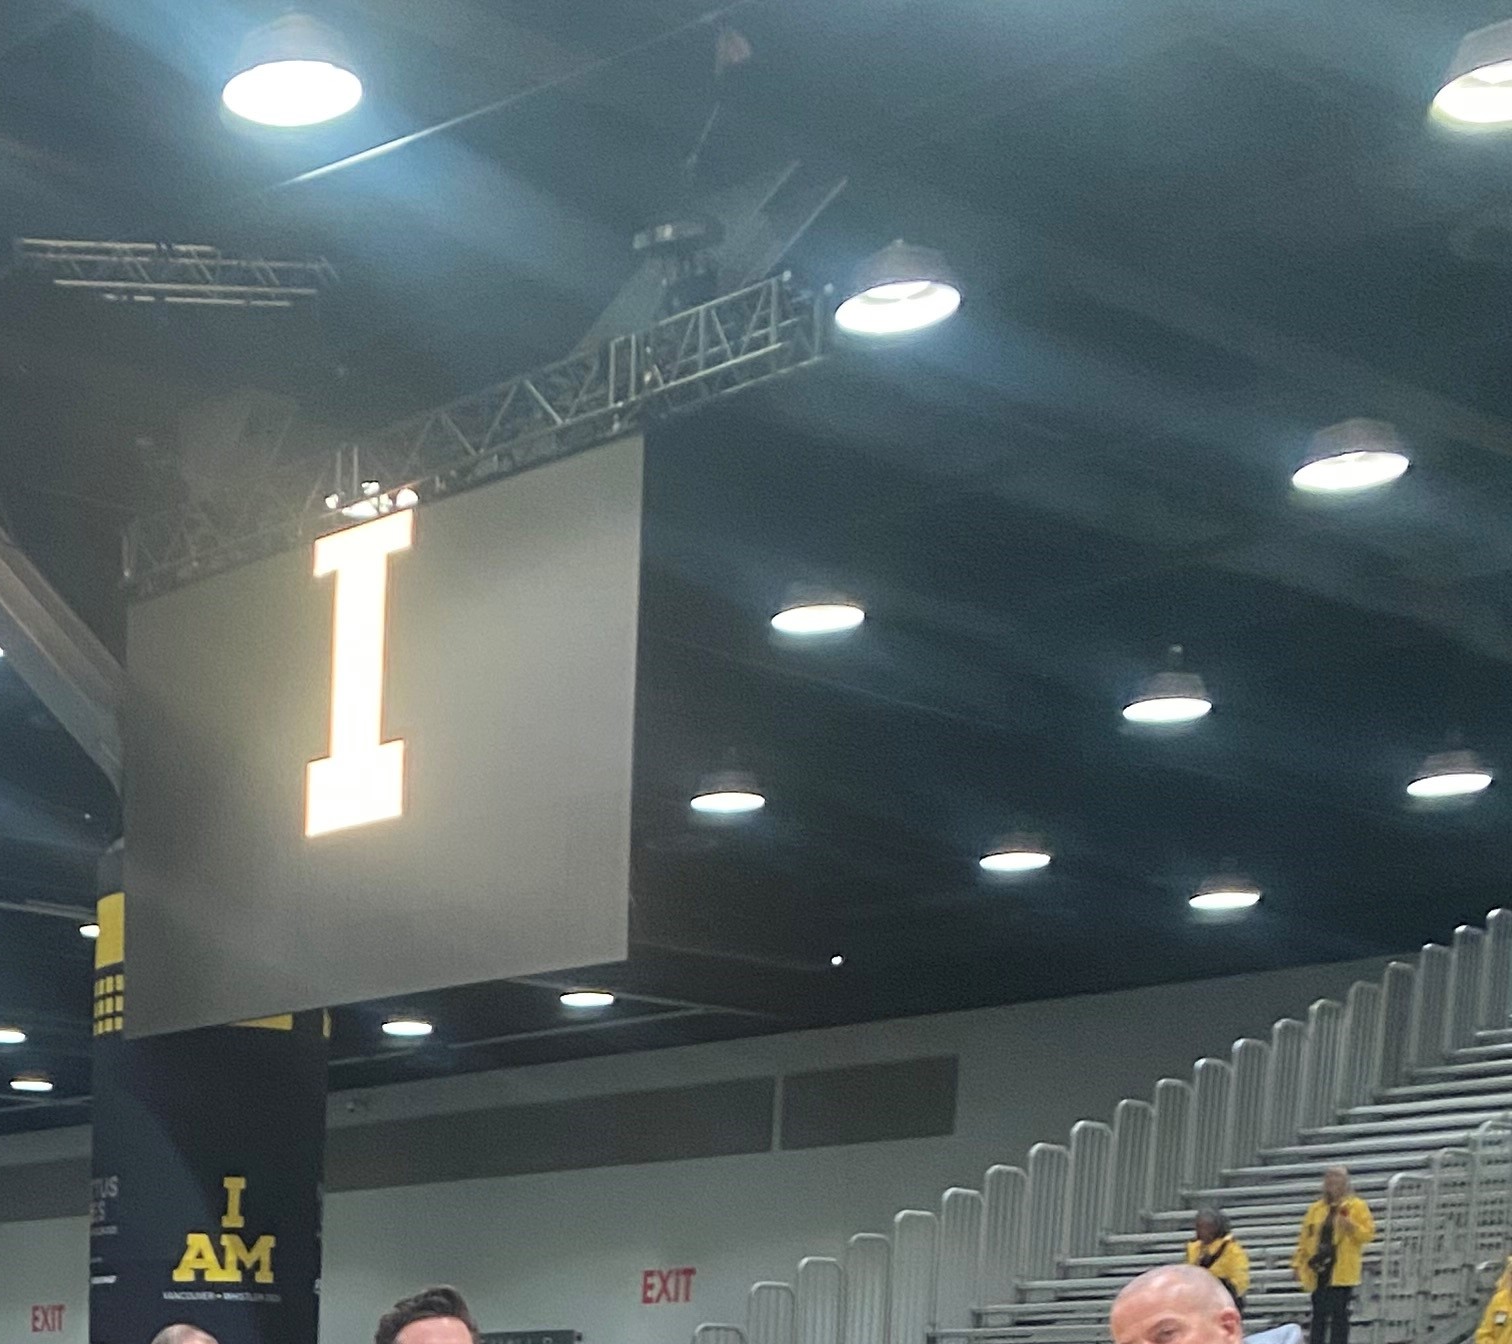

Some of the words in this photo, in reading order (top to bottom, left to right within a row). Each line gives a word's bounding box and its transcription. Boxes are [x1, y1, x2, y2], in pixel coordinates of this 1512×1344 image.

[306, 508, 413, 838] I
[221, 1176, 246, 1228] I
[173, 1233, 276, 1283] AM
[641, 1267, 696, 1304] EXIT
[31, 1304, 65, 1333] EXIT
